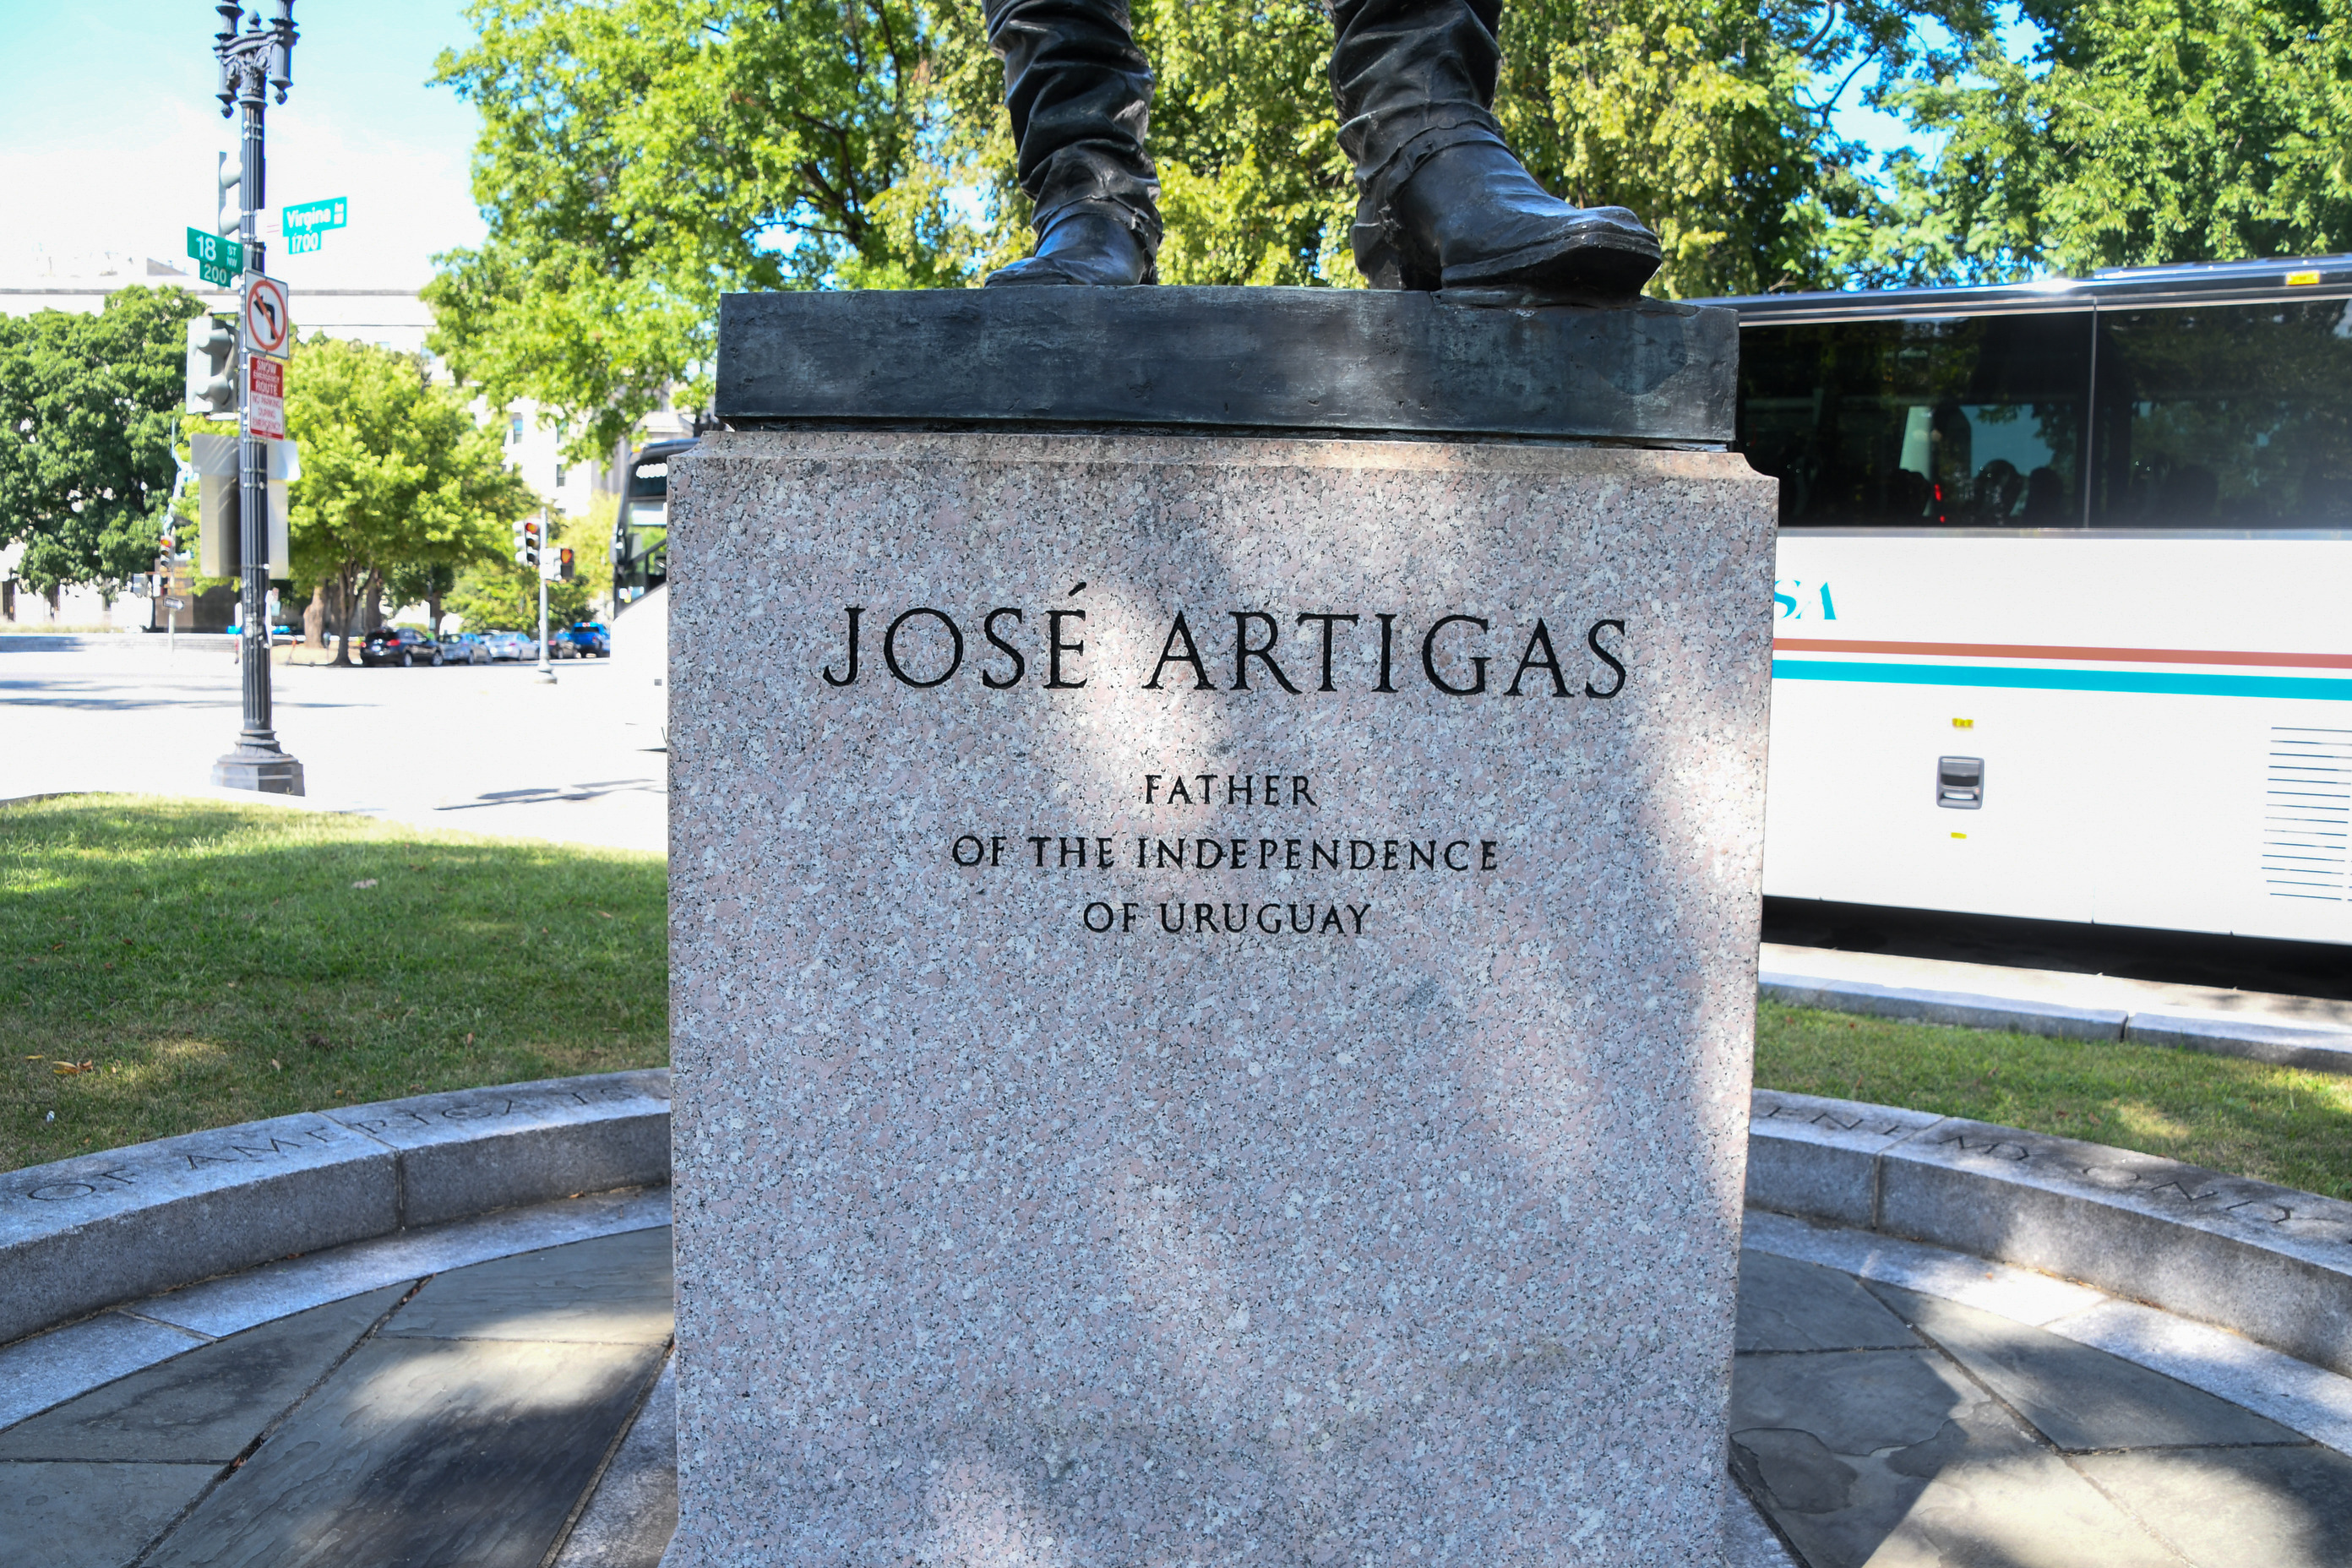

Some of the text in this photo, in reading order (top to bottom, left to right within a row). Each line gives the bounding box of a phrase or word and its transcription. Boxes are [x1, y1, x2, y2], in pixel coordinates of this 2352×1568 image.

[195, 234, 237, 262] 18 ST
[291, 232, 319, 253] 1700
[204, 263, 227, 285] 200
[256, 359, 277, 373] SNOW
[255, 379, 278, 396] ROUTE
[822, 582, 1628, 700] JOSÉ ARTIGAS
[1144, 775, 1319, 806] FATHER
[951, 835, 1499, 873] OF THE INDEPENDENCE
[1082, 901, 1372, 934] OF URUGUAY
[27, 1168, 141, 1201] OF
